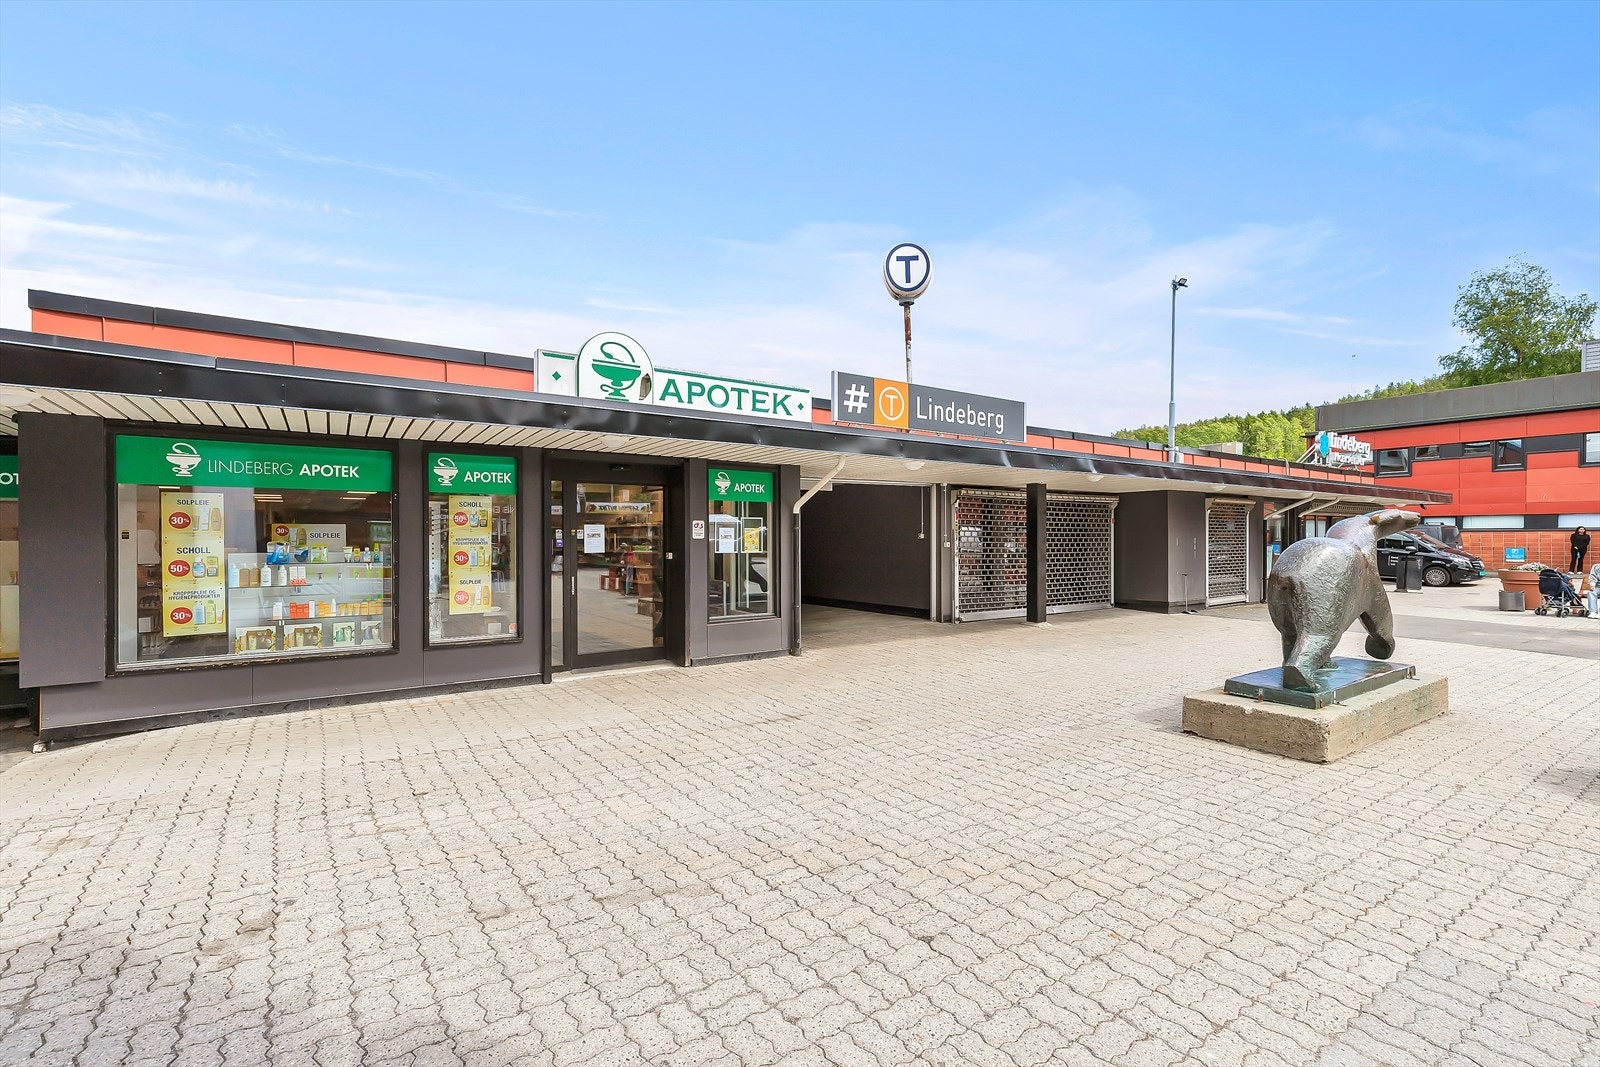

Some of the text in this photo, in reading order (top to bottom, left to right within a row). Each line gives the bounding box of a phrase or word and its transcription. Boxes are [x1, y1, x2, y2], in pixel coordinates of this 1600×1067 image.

[896, 255, 919, 283] T
[659, 378, 793, 416] APOTEK
[916, 396, 1004, 434] Lindeberg
[1328, 432, 1371, 458] Lindeberg
[208, 460, 360, 478] LINDEBERG APOTEK
[463, 471, 513, 484] APOTEK
[733, 483, 766, 494] APOTEK
[170, 516, 190, 525] 30%
[176, 546, 211, 555] SCHOLL
[170, 564, 189, 573] 50%
[172, 611, 192, 620] 30%
